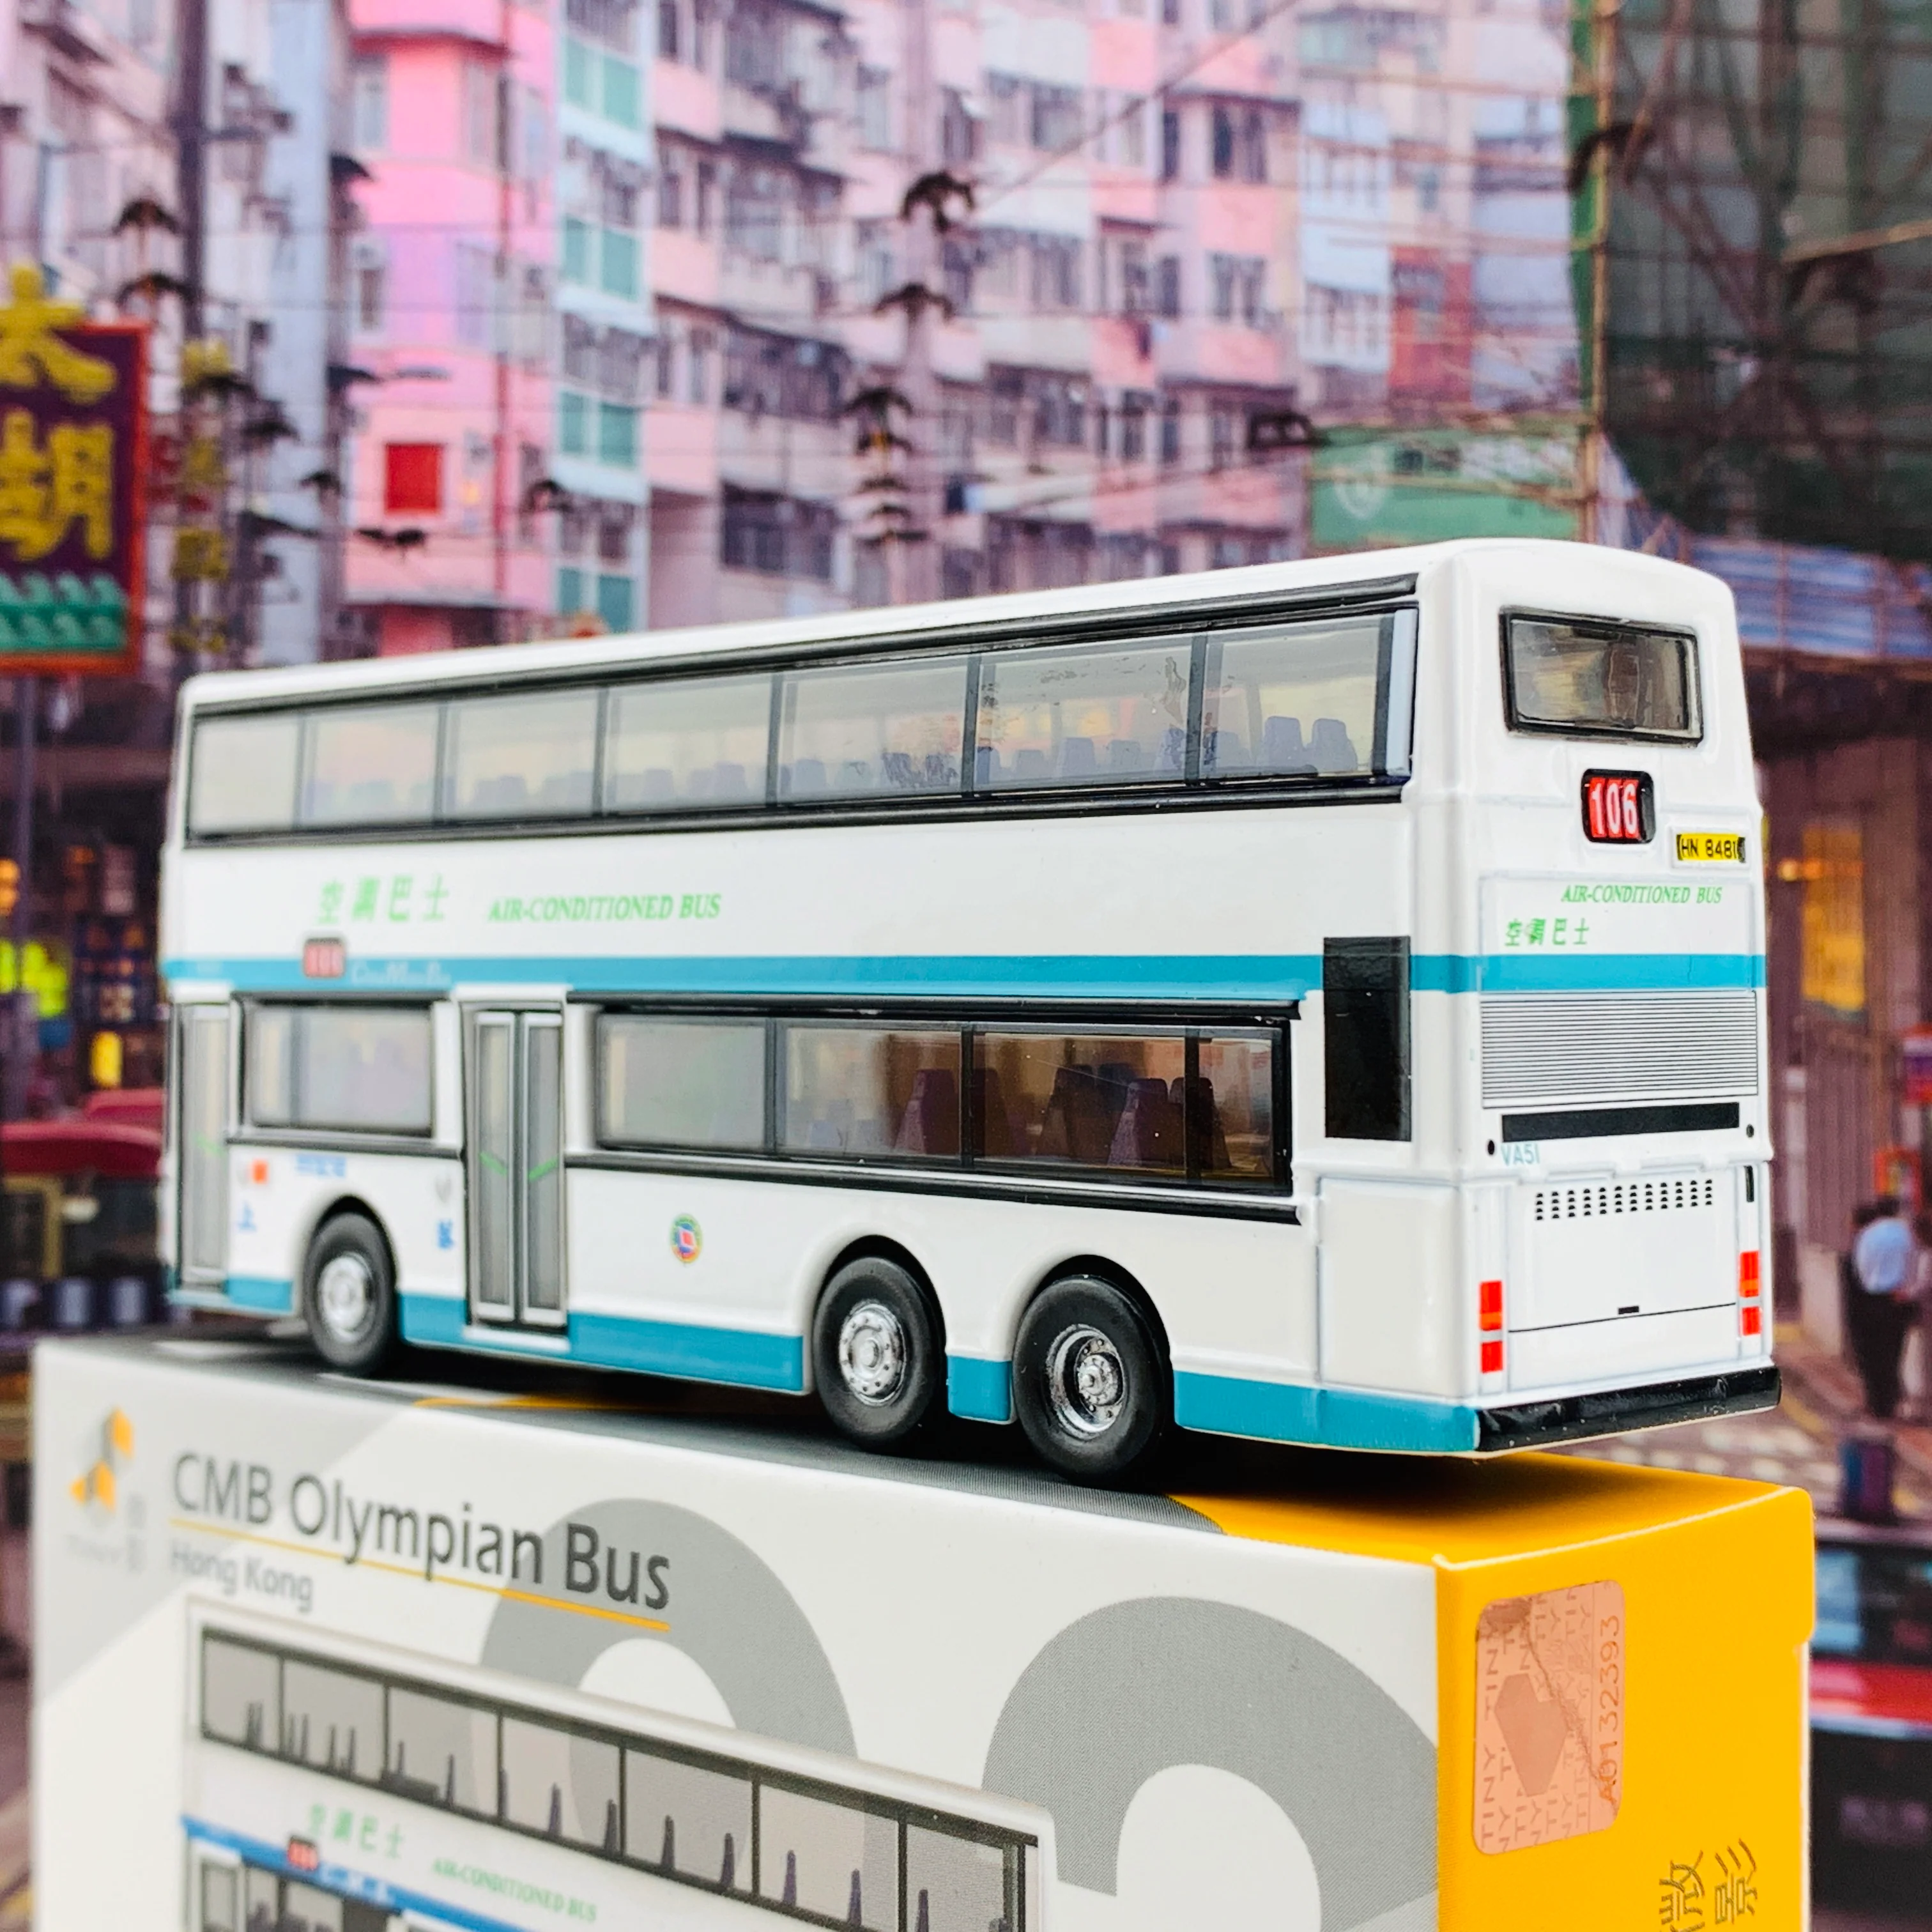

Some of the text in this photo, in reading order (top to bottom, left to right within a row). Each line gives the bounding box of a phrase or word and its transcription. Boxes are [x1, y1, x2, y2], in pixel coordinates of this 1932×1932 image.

[1591, 782, 1638, 835] 106
[1682, 838, 1737, 859] HN 8481
[488, 893, 721, 921] AIR-CONDITIONED BUS
[1561, 885, 1722, 903] AIR-CONDITIONED BUS
[1501, 1143, 1540, 1165] VA51
[174, 1452, 671, 1610] CMB Olympian Bus
[170, 1542, 237, 1595] Hong
[245, 1556, 313, 1613] Kong
